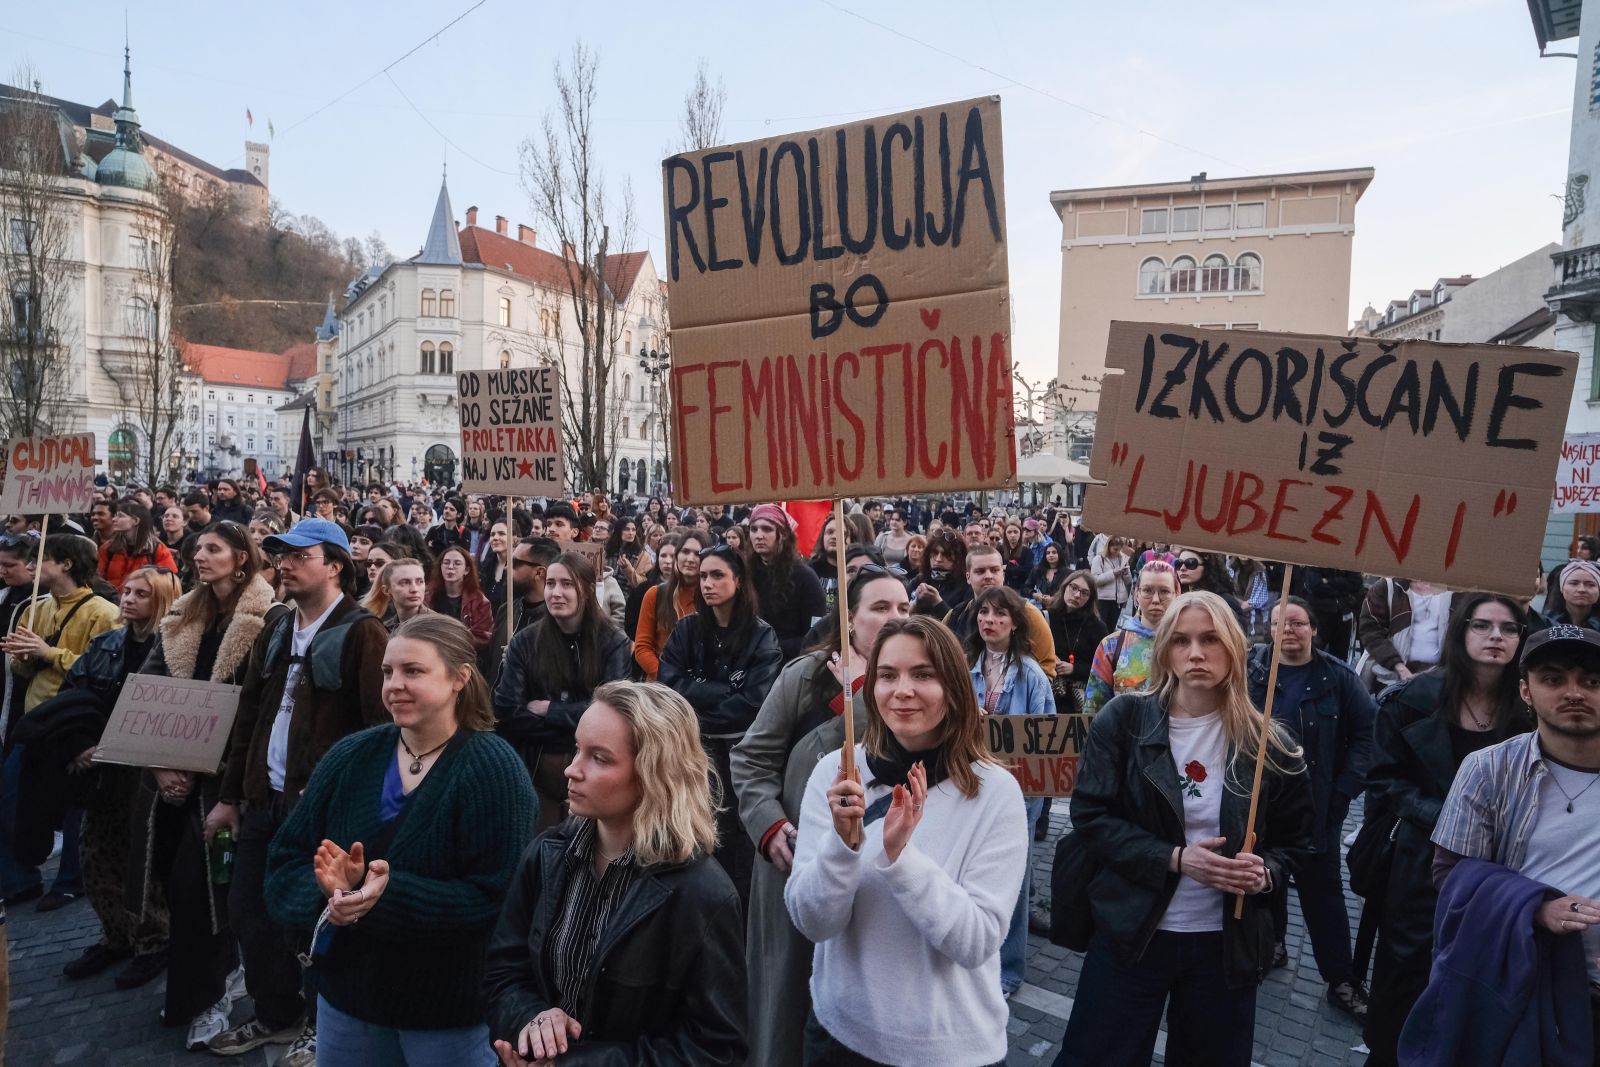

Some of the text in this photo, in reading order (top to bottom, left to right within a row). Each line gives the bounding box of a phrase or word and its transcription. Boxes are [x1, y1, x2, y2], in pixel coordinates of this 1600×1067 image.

[664, 107, 1003, 282] REVOLUCIJA
[810, 273, 890, 340] BO
[459, 368, 553, 397] OD MURSKE
[1135, 333, 1566, 452] IZKORIŠČANE
[461, 395, 554, 427] DO SEŽANE
[675, 308, 1018, 500] FEMINISTIČNA
[462, 427, 557, 453] PROLETARKA
[1299, 430, 1354, 476] IZ
[463, 457, 487, 481] NAJ
[1572, 467, 1590, 484] NI
[14, 469, 93, 510] THINKING
[131, 683, 215, 709] DOVOLJ JE
[119, 710, 219, 744] FEMICIDOV!
[988, 718, 1015, 754] DO
